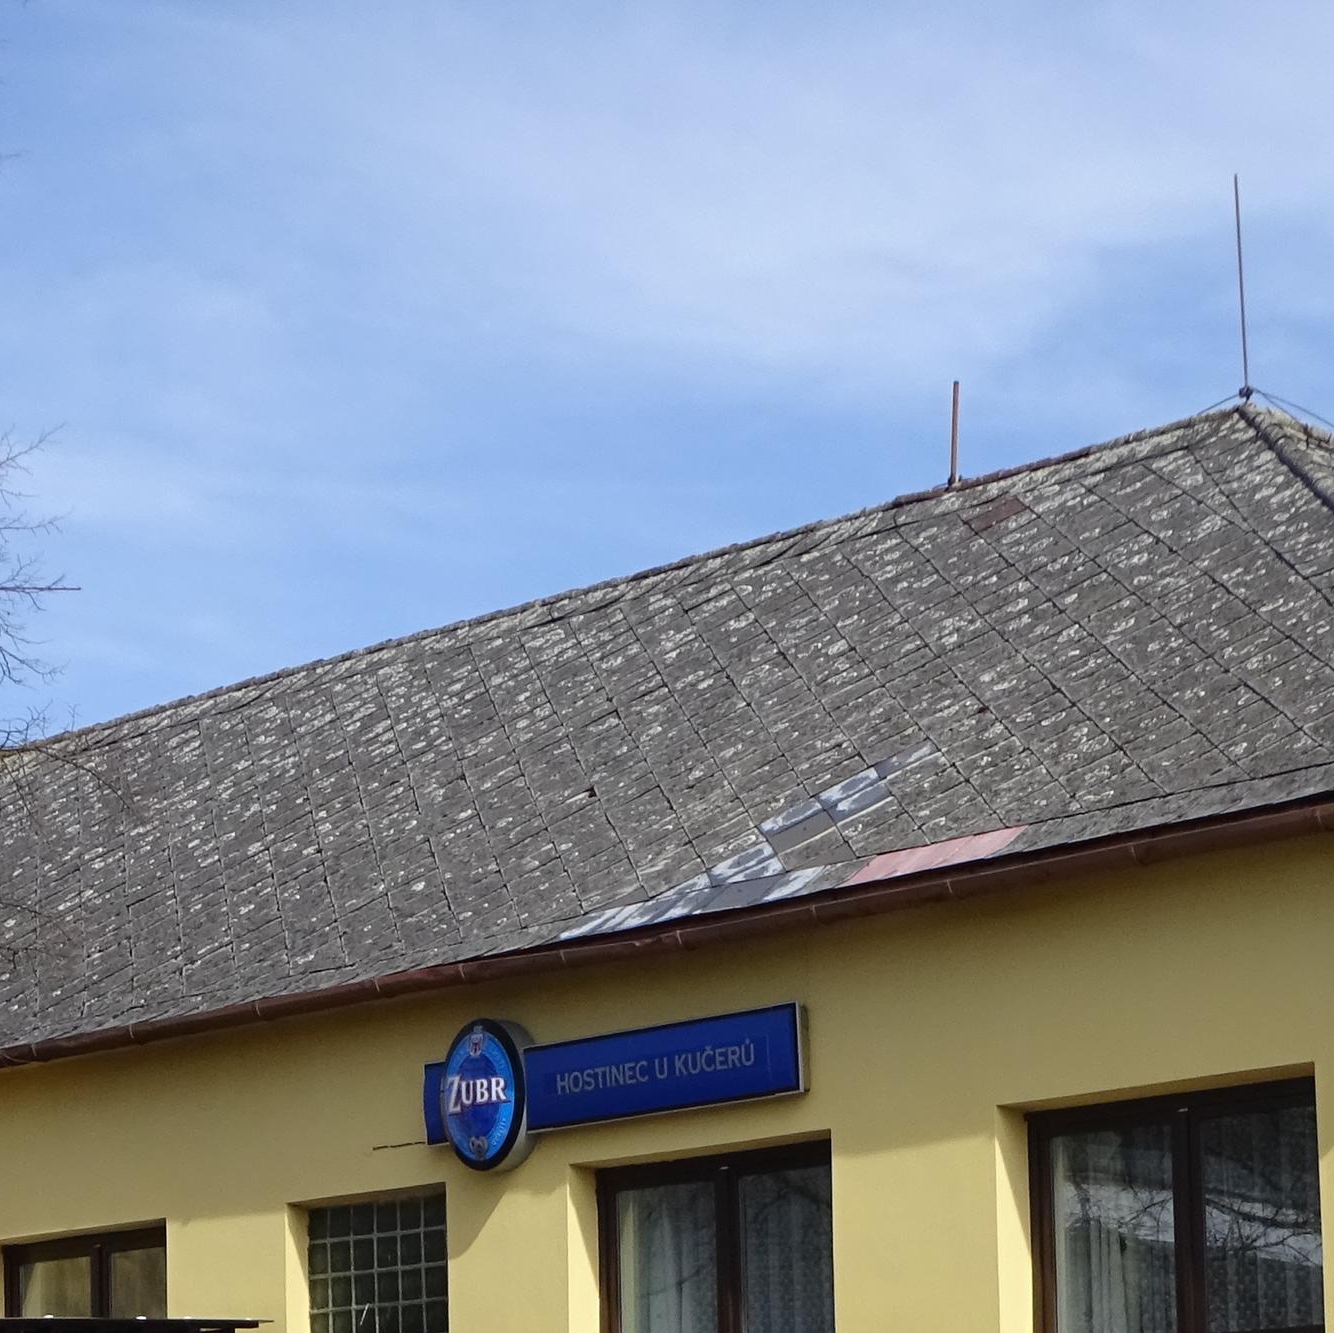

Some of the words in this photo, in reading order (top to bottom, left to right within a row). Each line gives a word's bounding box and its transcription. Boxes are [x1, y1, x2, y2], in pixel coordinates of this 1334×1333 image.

[555, 1060, 649, 1096] HOSTINEC
[654, 1057, 668, 1079] U
[674, 1038, 756, 1078] KUČERŮ
[446, 1073, 507, 1113] ZUBR
